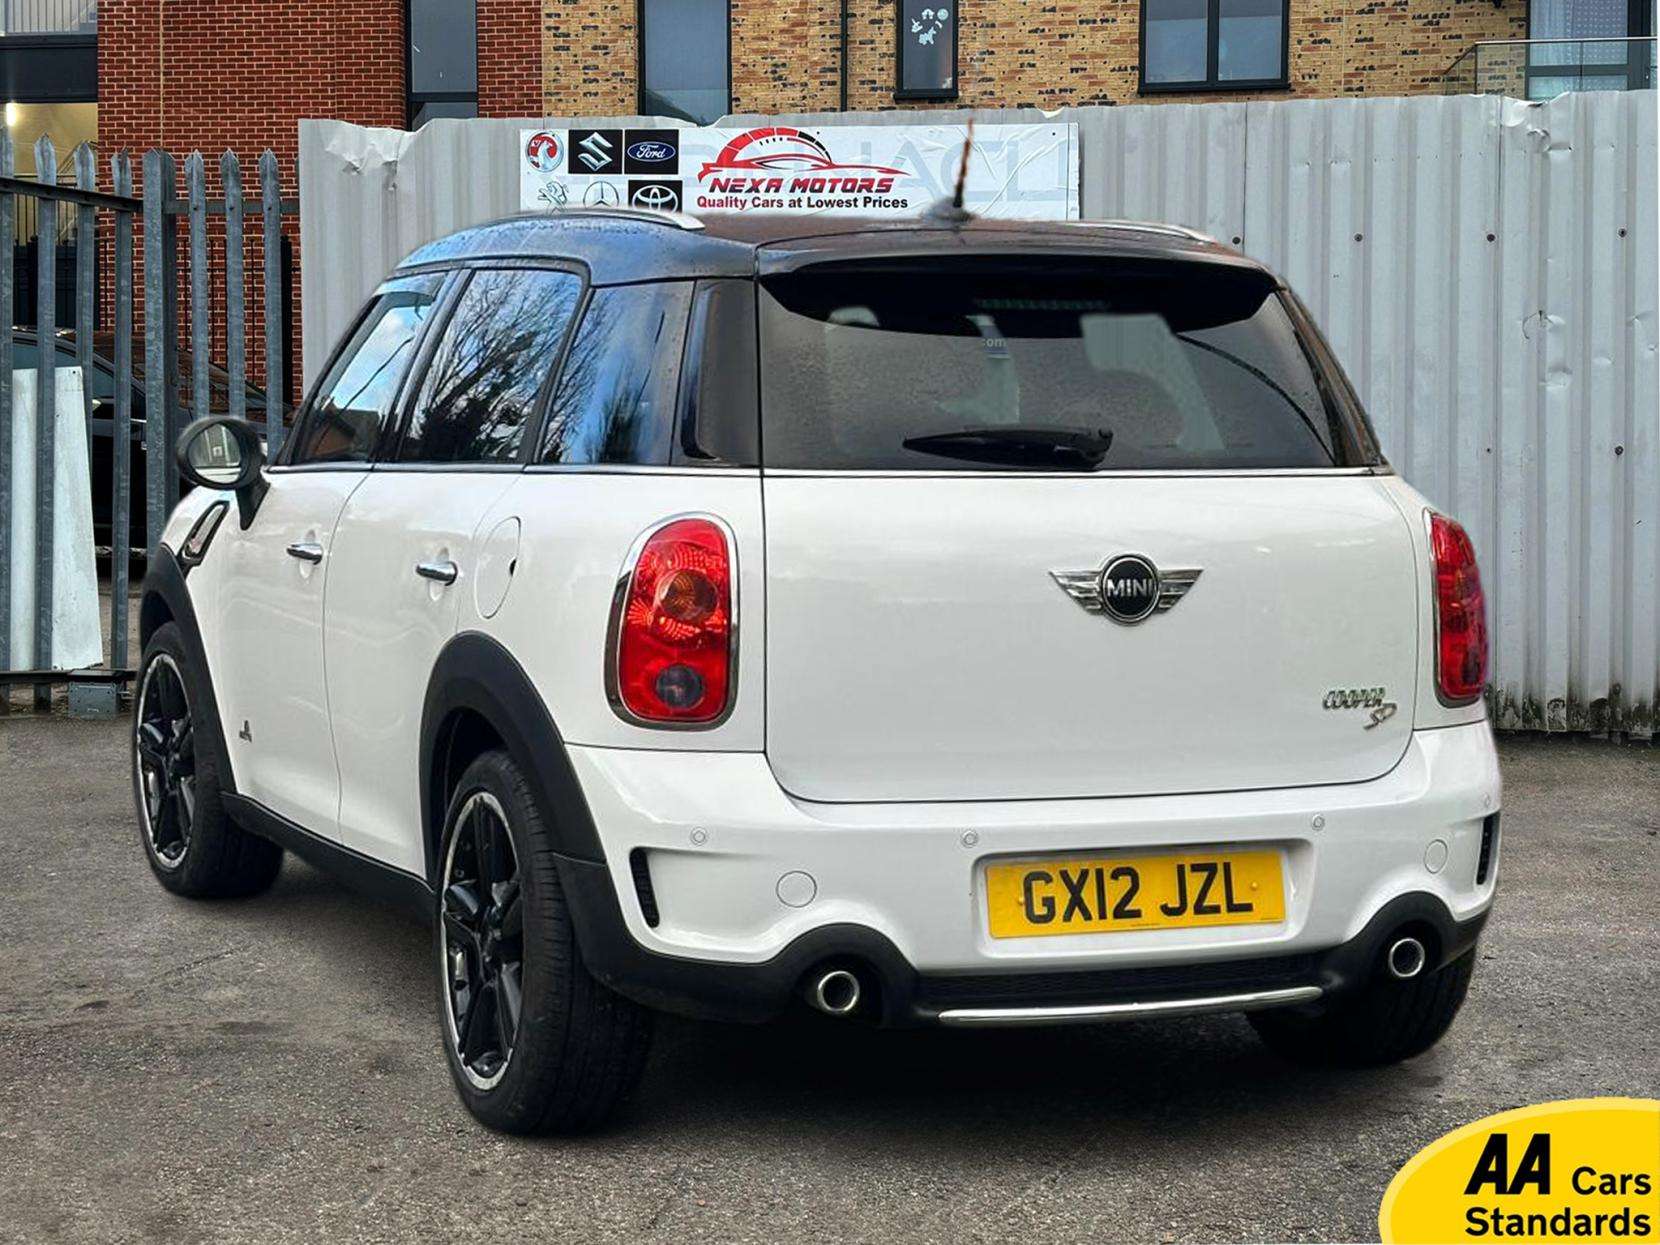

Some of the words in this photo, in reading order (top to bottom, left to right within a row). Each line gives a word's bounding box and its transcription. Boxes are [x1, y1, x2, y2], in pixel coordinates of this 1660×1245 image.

[636, 144, 666, 158] Ford
[709, 178, 783, 193] NEXA
[789, 178, 894, 193] MOTORS
[697, 196, 747, 210] Quality
[751, 197, 784, 208] Cars
[788, 197, 802, 208] at
[807, 197, 858, 208] Lowest
[863, 197, 908, 208] Prices
[1107, 579, 1153, 597] MINI
[1323, 688, 1385, 709] COOPER
[1023, 866, 1142, 924] GX12
[1160, 861, 1253, 917] JZL
